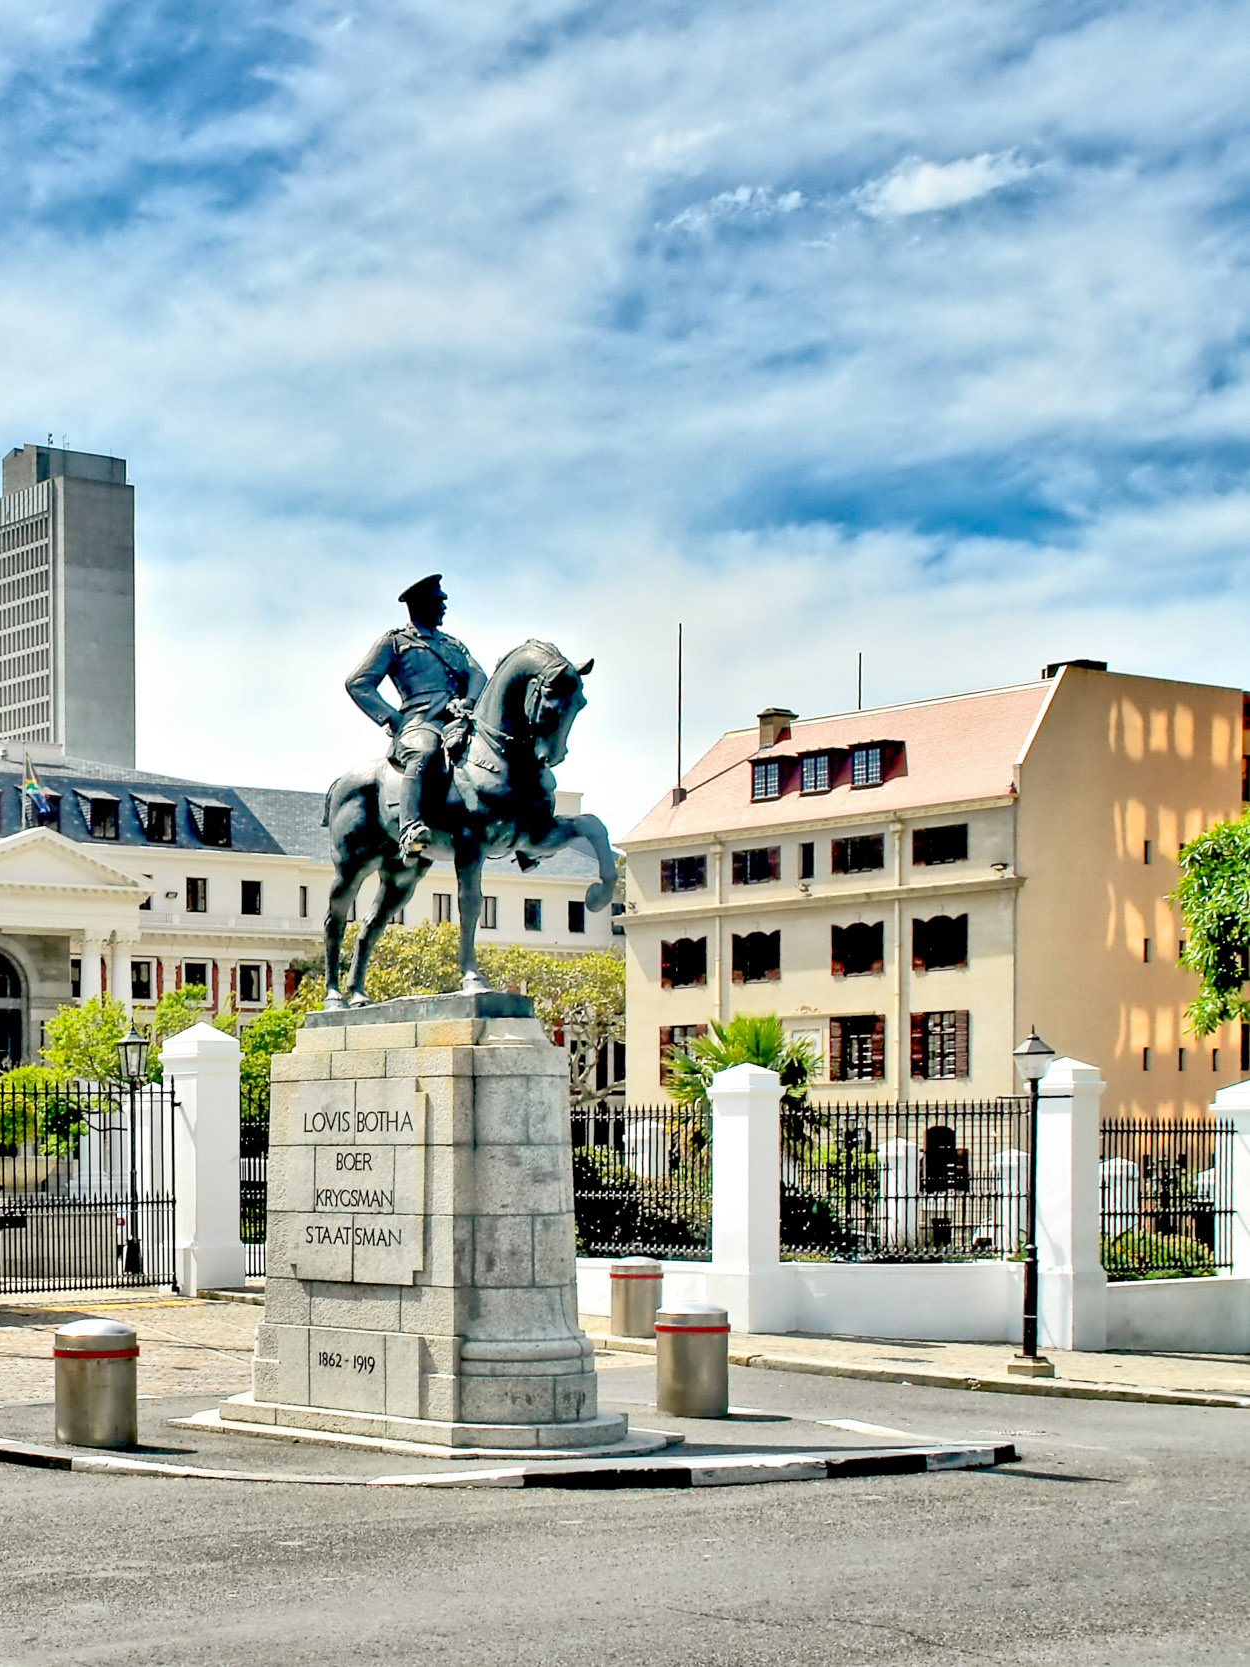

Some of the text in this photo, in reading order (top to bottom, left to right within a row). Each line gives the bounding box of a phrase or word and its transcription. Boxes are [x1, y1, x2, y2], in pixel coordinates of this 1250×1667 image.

[356, 1111, 414, 1132] BOTHA
[336, 1152, 372, 1171] BOER
[315, 1189, 393, 1207] KRYGSMAN
[319, 1351, 342, 1368] 1862
[353, 1355, 375, 1374] 1919
